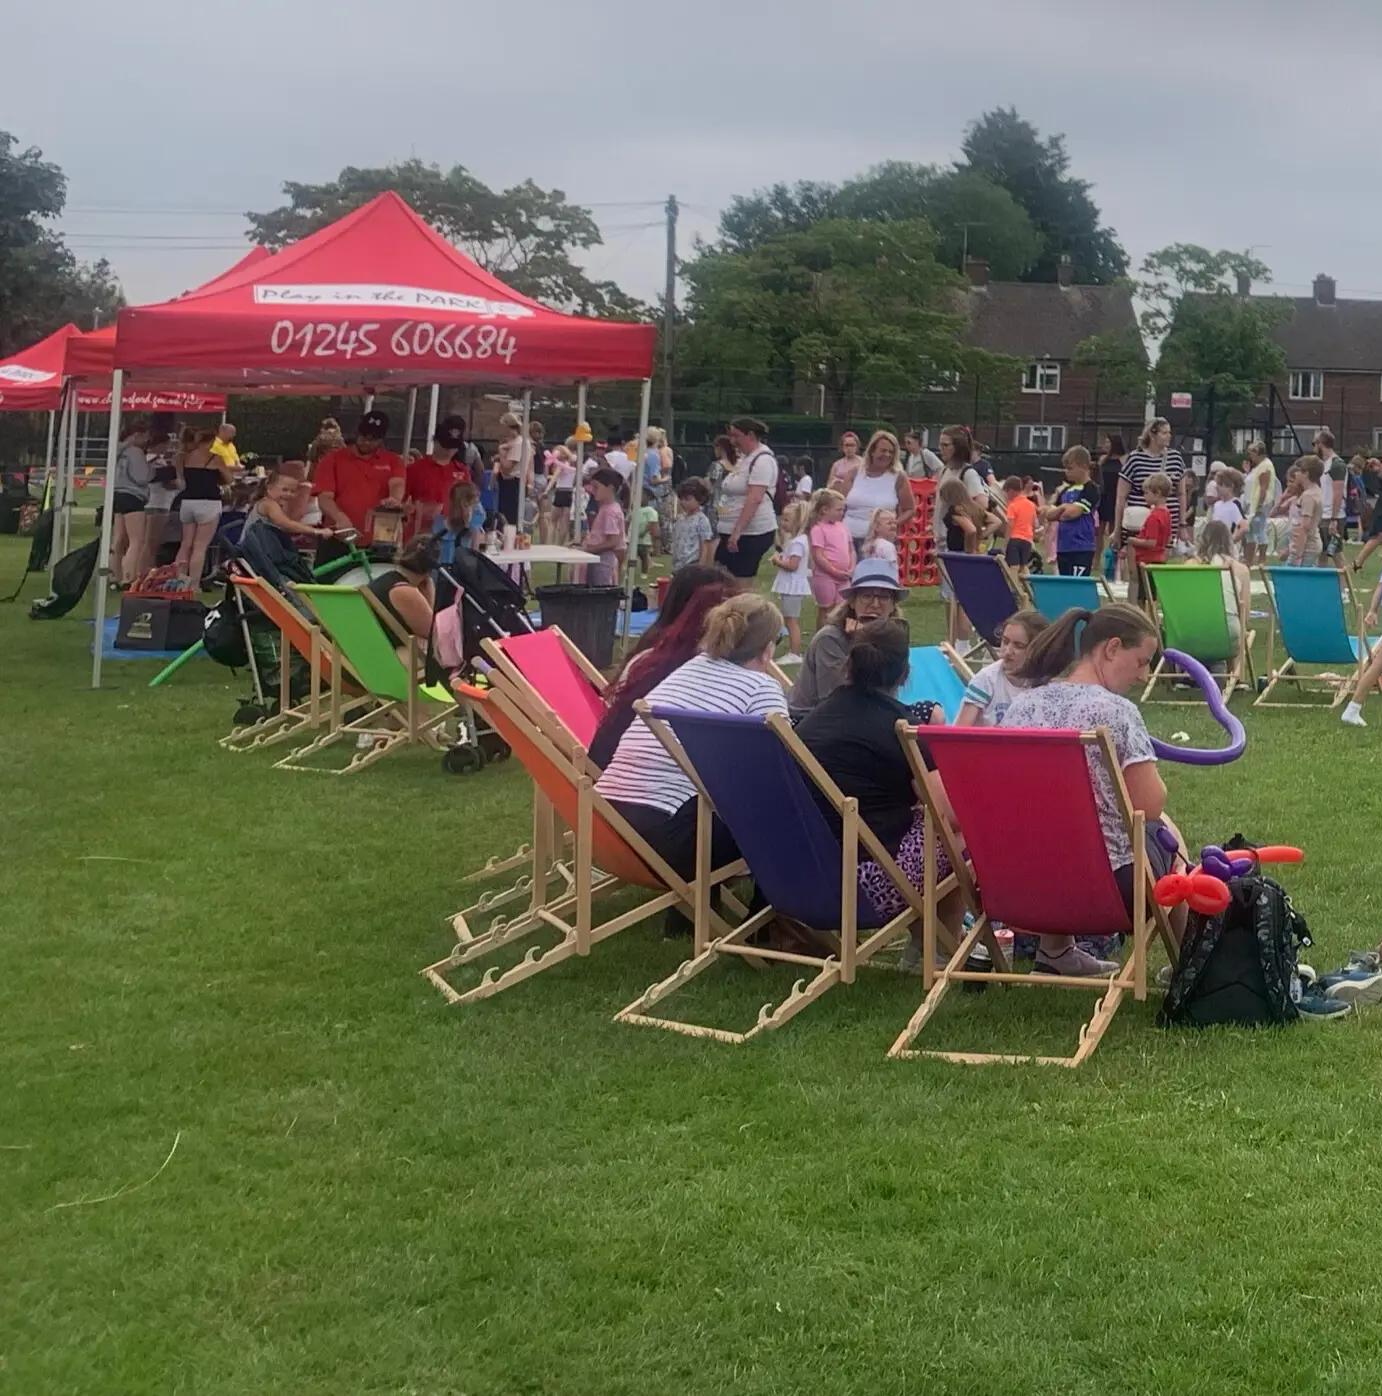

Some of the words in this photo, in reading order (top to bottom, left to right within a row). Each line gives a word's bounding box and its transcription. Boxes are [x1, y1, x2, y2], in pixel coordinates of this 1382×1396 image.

[271, 319, 380, 360] 01245
[390, 319, 517, 365] 606684
[1072, 565, 1086, 577] 17
